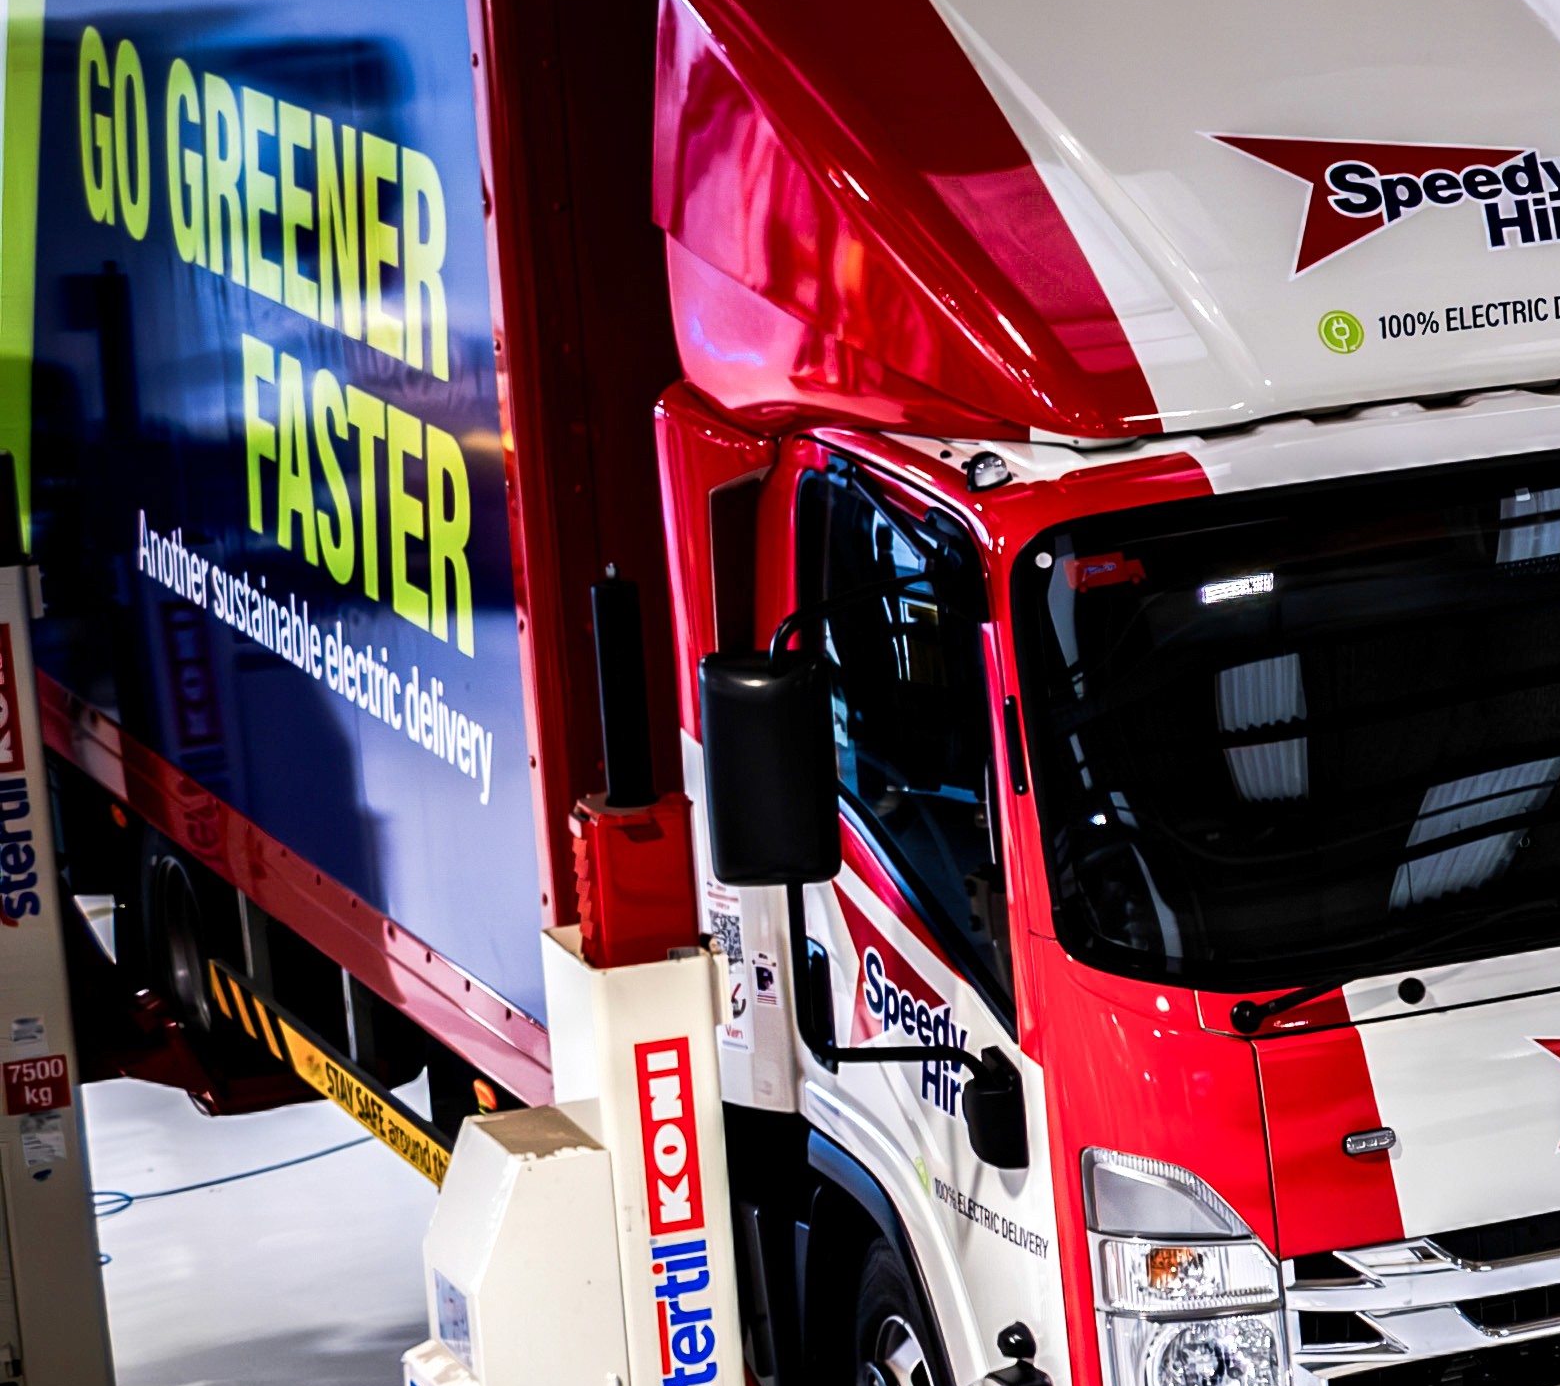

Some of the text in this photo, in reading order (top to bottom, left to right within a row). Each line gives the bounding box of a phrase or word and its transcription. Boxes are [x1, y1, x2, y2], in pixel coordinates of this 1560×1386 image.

[79, 25, 449, 382] GO GREENER
[1379, 311, 1440, 340] 100%
[1445, 296, 1548, 333] ELECTRIC
[240, 332, 475, 658] FASTER
[138, 509, 495, 806] Another sustainable electric delivery
[864, 949, 967, 1074] Speedy
[8, 1058, 65, 1081] 7500
[26, 1082, 53, 1106] kg
[325, 1061, 354, 1113] STAY
[355, 1086, 387, 1139] SAFE
[387, 1118, 431, 1175] around
[922, 1059, 966, 1117] Hir
[650, 1049, 692, 1223] KONI
[935, 1176, 1049, 1260] 100% ELECTRIC DELIVERY
